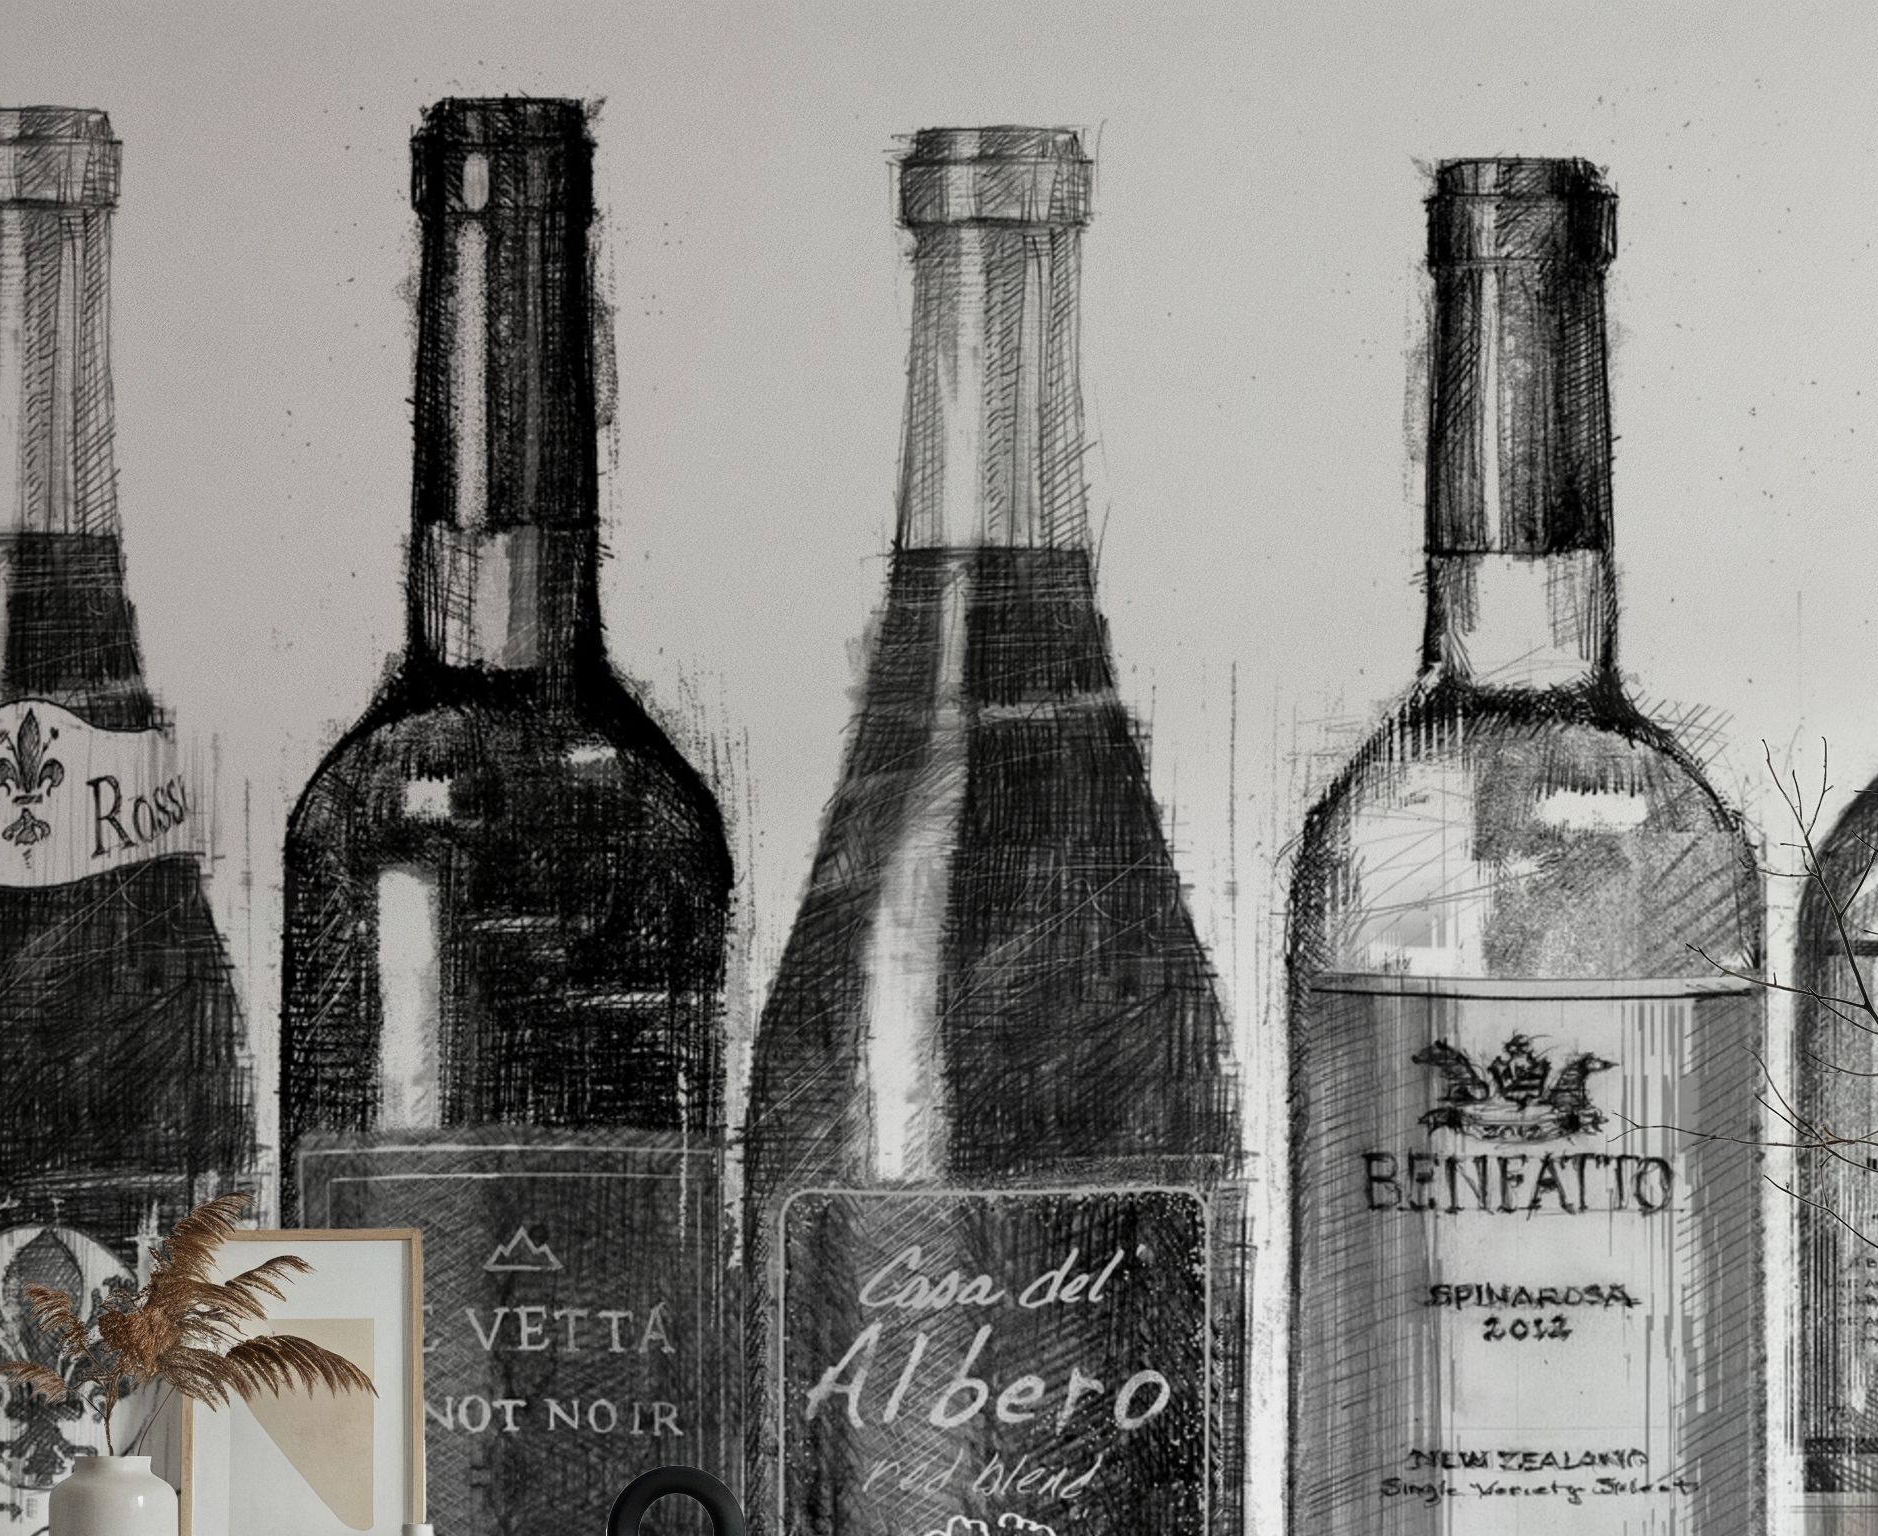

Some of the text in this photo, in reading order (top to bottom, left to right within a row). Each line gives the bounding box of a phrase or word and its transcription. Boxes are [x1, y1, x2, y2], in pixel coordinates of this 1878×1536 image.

[1019, 1247, 1124, 1309] del
[465, 1302, 676, 1354] VETTA
[805, 1322, 1172, 1430] Albero
[543, 1398, 684, 1436] NOIR
